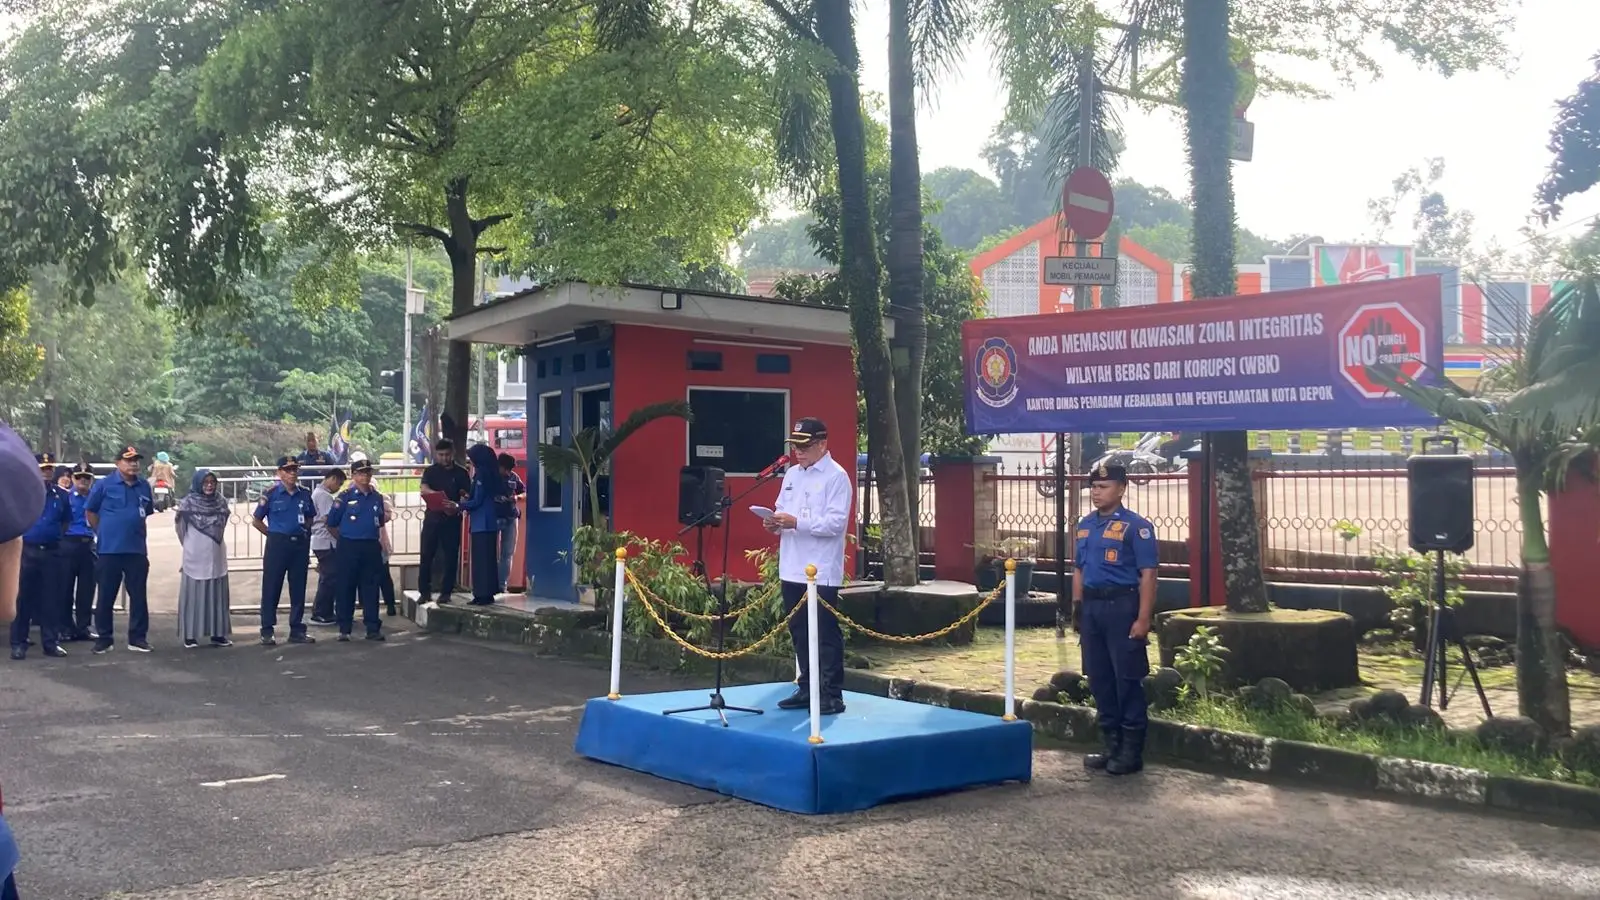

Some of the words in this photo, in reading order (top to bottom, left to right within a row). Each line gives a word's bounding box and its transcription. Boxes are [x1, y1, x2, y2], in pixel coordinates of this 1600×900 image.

[1050, 272, 1072, 280] MOBIL
[1074, 272, 1111, 280] PEMADAM
[1062, 261, 1099, 270] KECUALI
[1028, 335, 1059, 356] ANDA
[1061, 329, 1127, 354] MEMASUKI
[1130, 324, 1195, 349] KAWASAN
[1198, 320, 1236, 344] ZONA
[1239, 313, 1324, 341] INTEGRITAS
[1377, 332, 1407, 346] PUNGLI
[1345, 334, 1377, 367] NO
[1065, 364, 1112, 384] WILAYAH
[1115, 362, 1150, 382] BEBAS
[1153, 360, 1181, 380] DARI
[1184, 356, 1236, 378] KORUPSI
[1239, 354, 1280, 375] (WBK)
[1026, 396, 1055, 411] KANTOR
[1056, 395, 1079, 410] DINAS
[1081, 394, 1122, 409] PEMADAM
[1124, 392, 1174, 408] KEBAKARAN
[1175, 392, 1194, 406] DAN
[1195, 388, 1269, 405] PENYELAMATAN
[1271, 387, 1297, 402] KOTA
[1299, 385, 1334, 401] DEPOK
